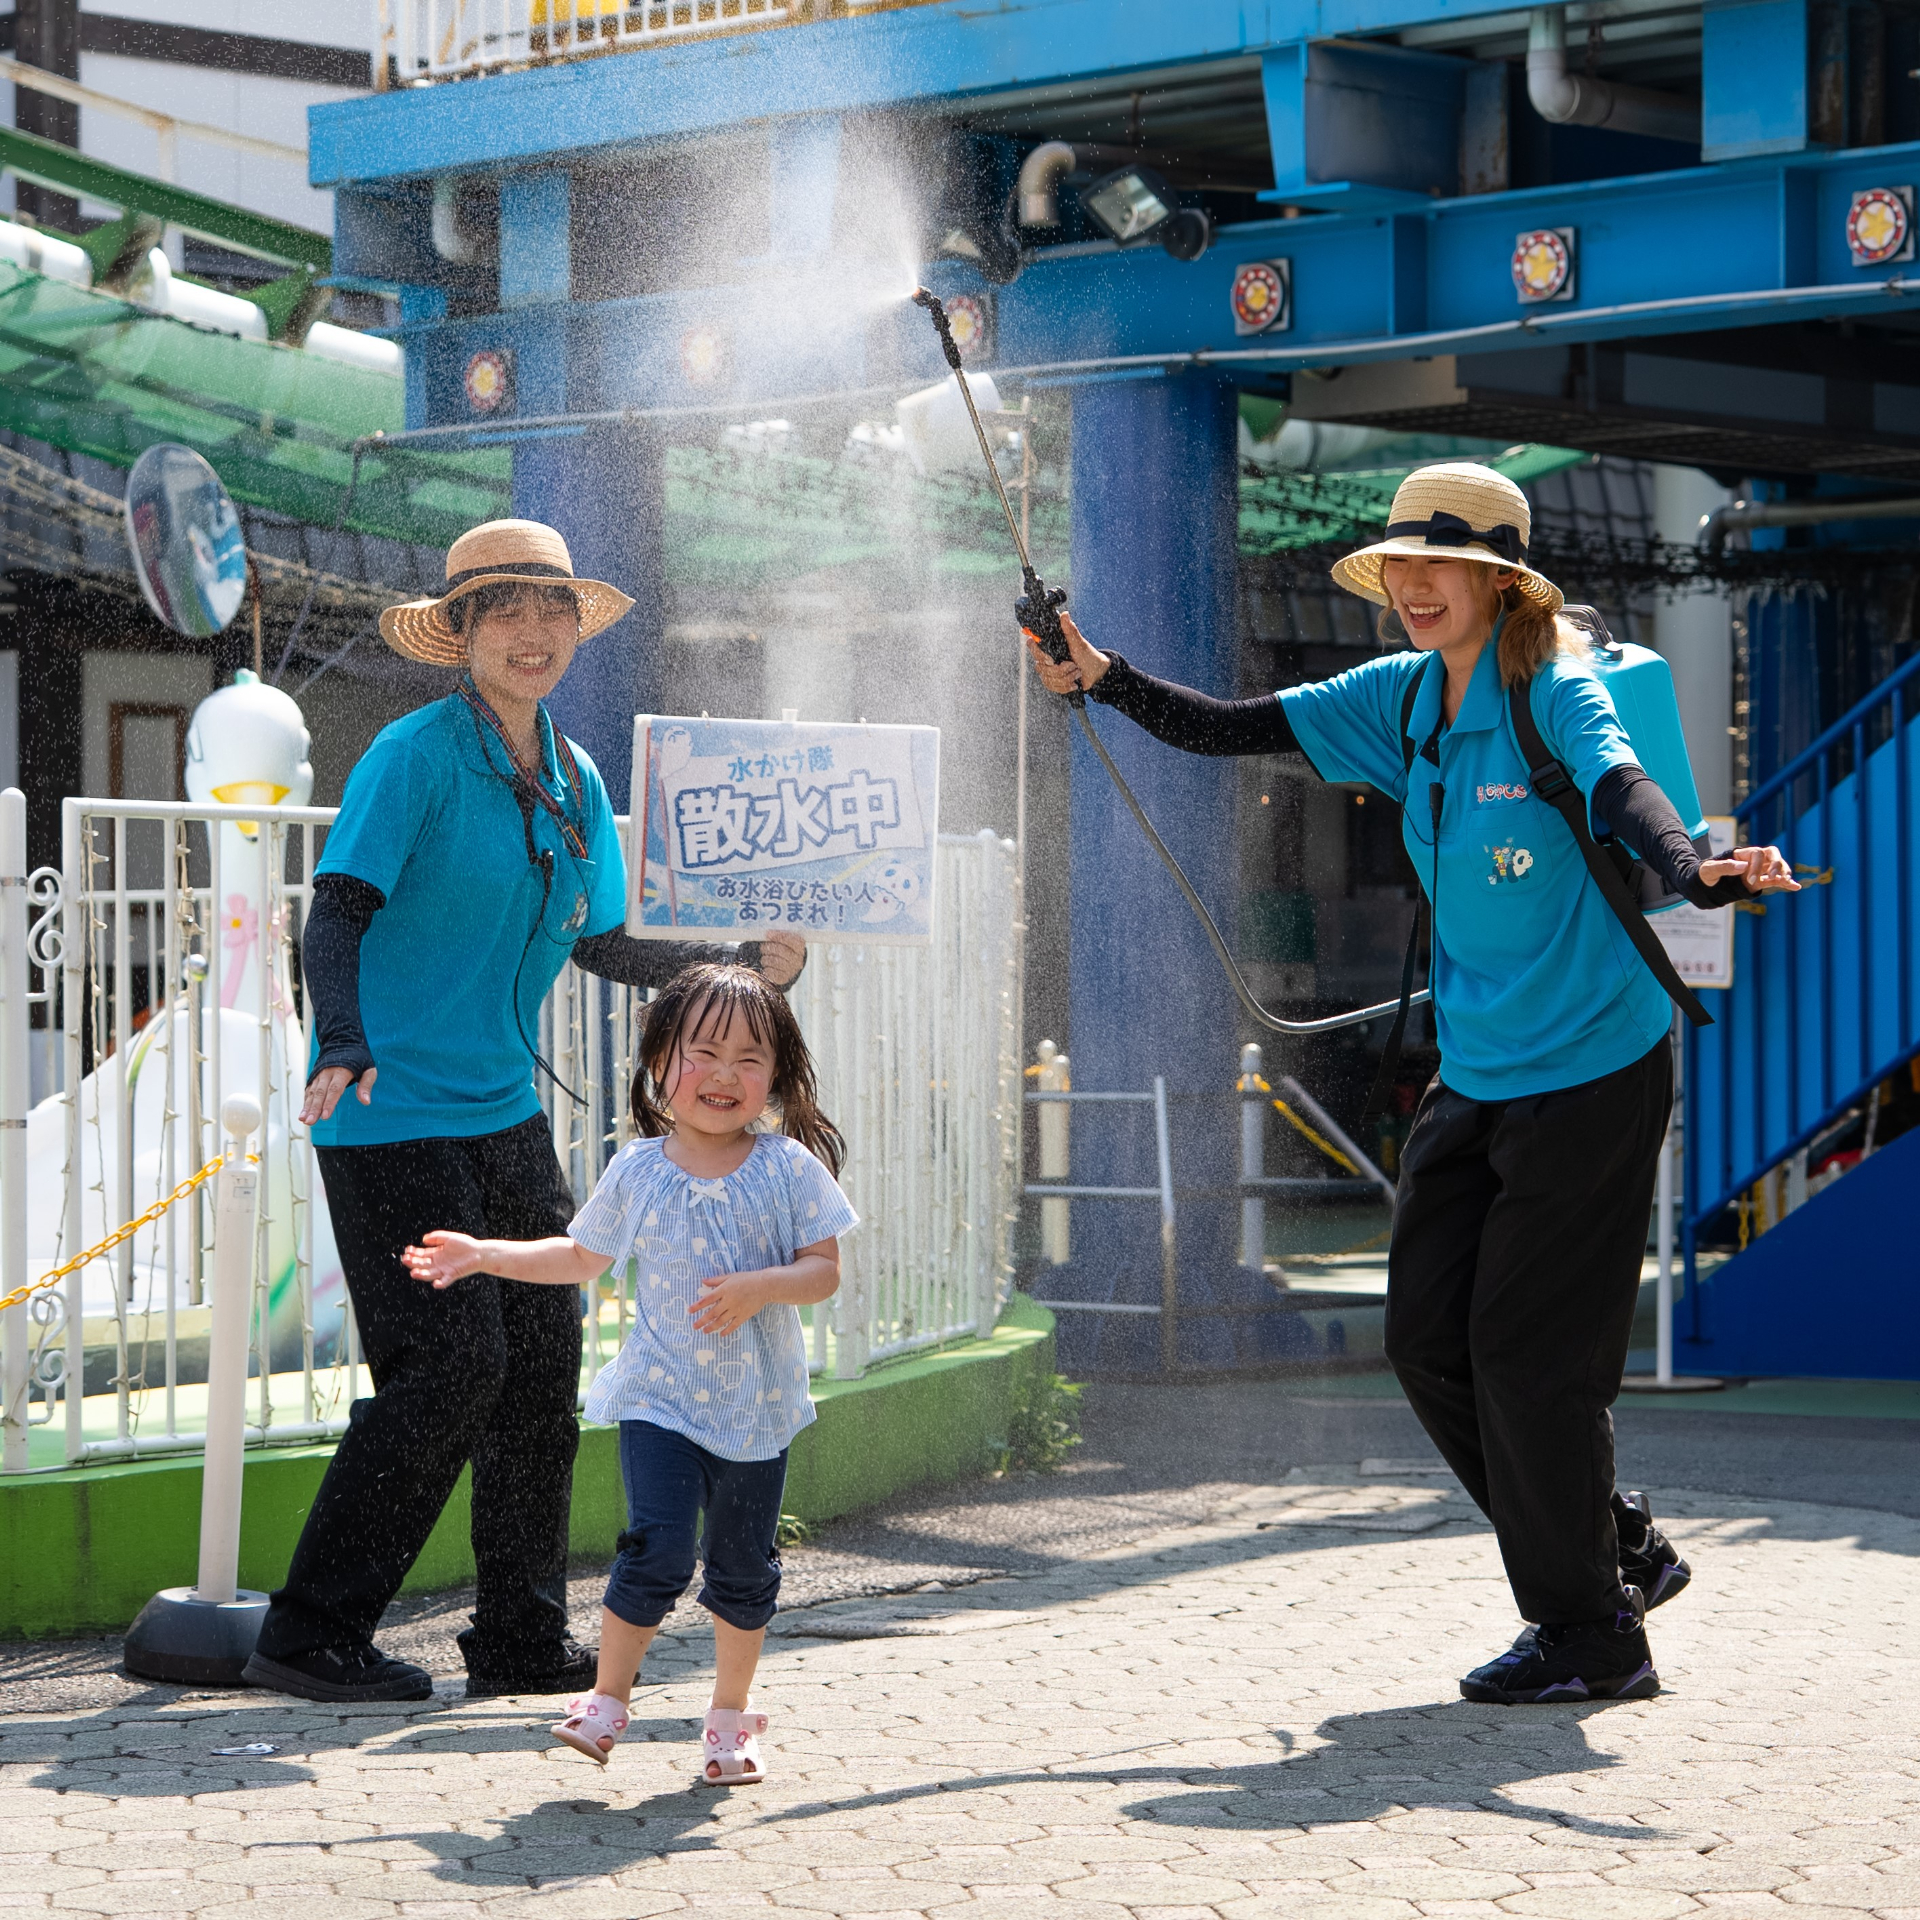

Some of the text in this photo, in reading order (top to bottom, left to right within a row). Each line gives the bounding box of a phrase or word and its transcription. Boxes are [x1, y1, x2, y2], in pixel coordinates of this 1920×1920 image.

[727, 745, 835, 783] 水かけ隊
[675, 770, 900, 868] 散水中
[716, 876, 875, 904] お水浴びたい人
[738, 899, 844, 924] あつまれ！
